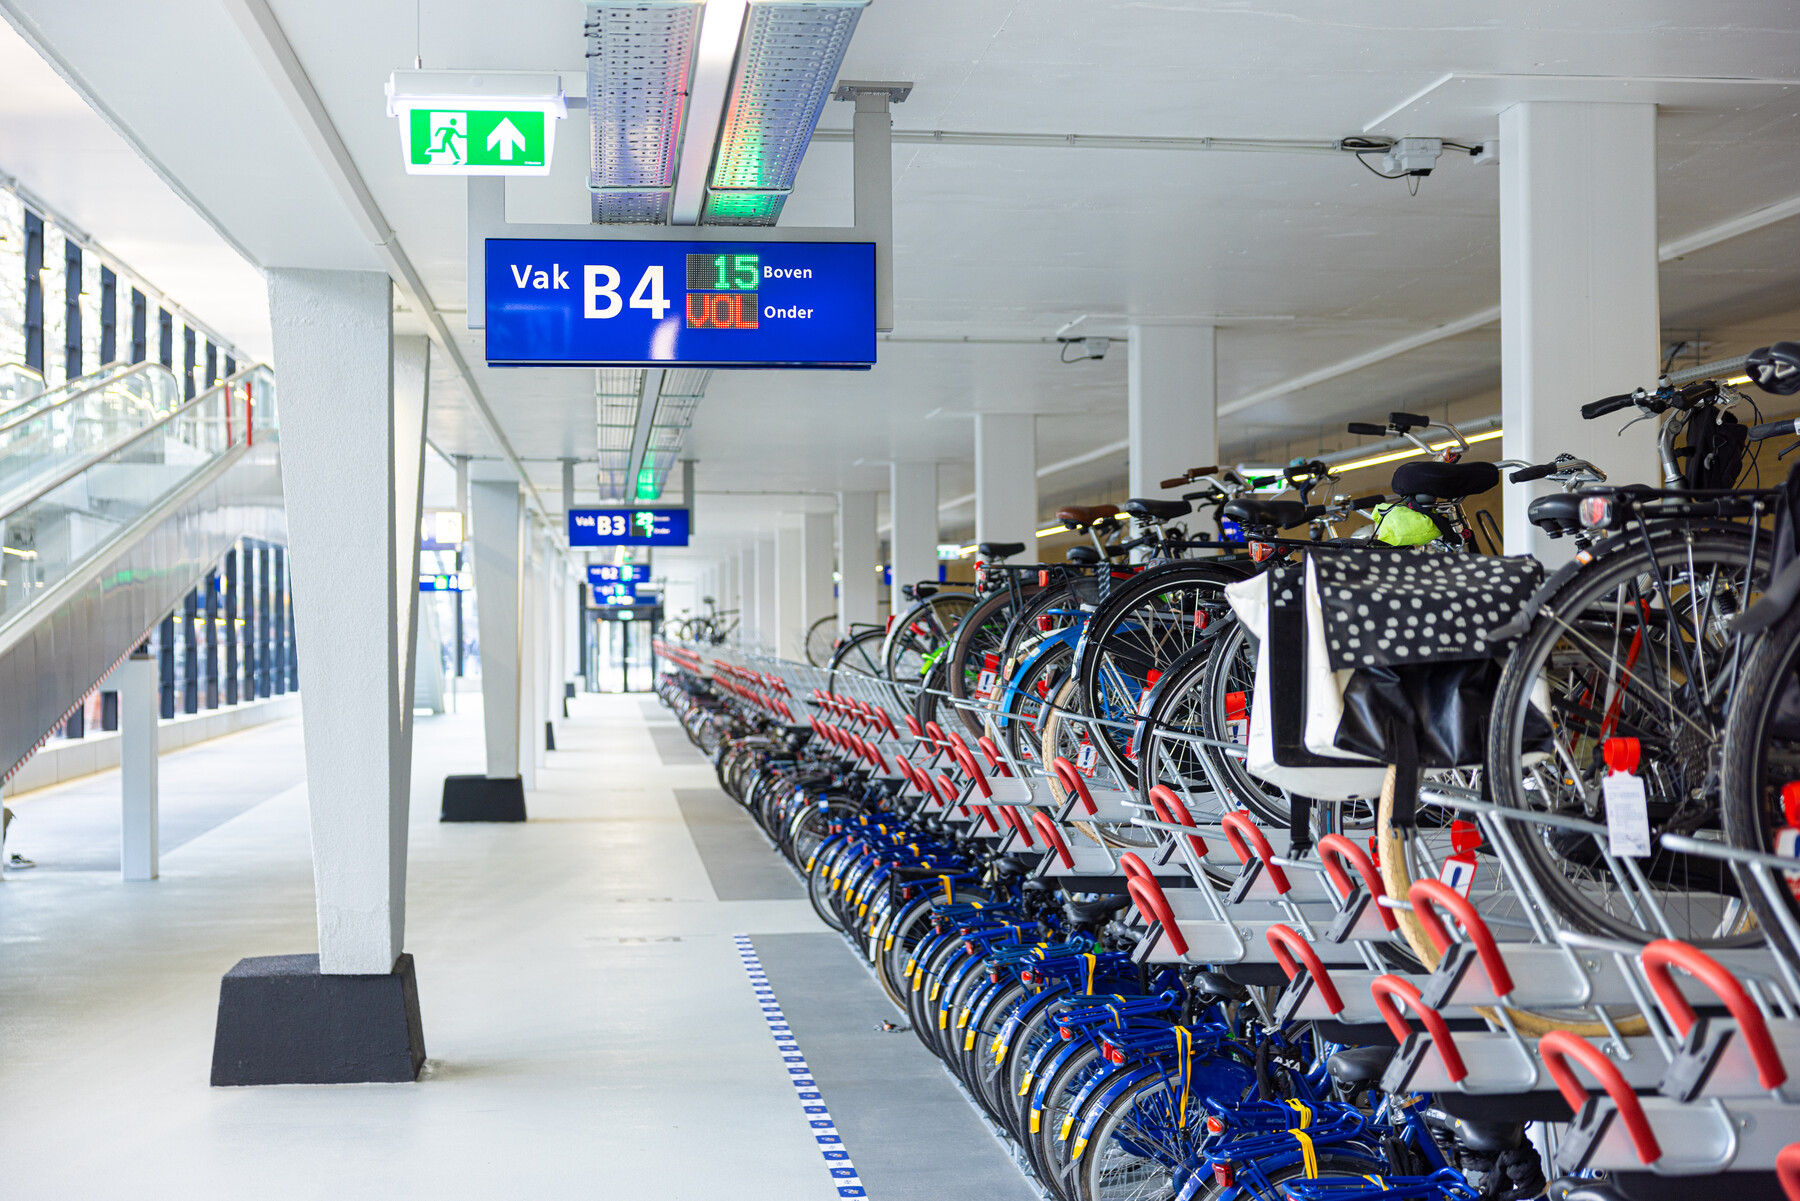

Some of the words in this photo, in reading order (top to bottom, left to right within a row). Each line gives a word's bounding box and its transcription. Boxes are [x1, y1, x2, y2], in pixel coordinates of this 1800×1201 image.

[714, 254, 759, 290] 15
[763, 265, 813, 279] Boven
[511, 264, 569, 290] Vak
[583, 264, 671, 320] B4
[686, 295, 759, 328] VOL
[763, 305, 814, 320] Onder
[575, 515, 596, 527] Vak
[597, 515, 626, 536] B3
[635, 511, 655, 526] 29
[1272, 1056, 1301, 1072] AXA
